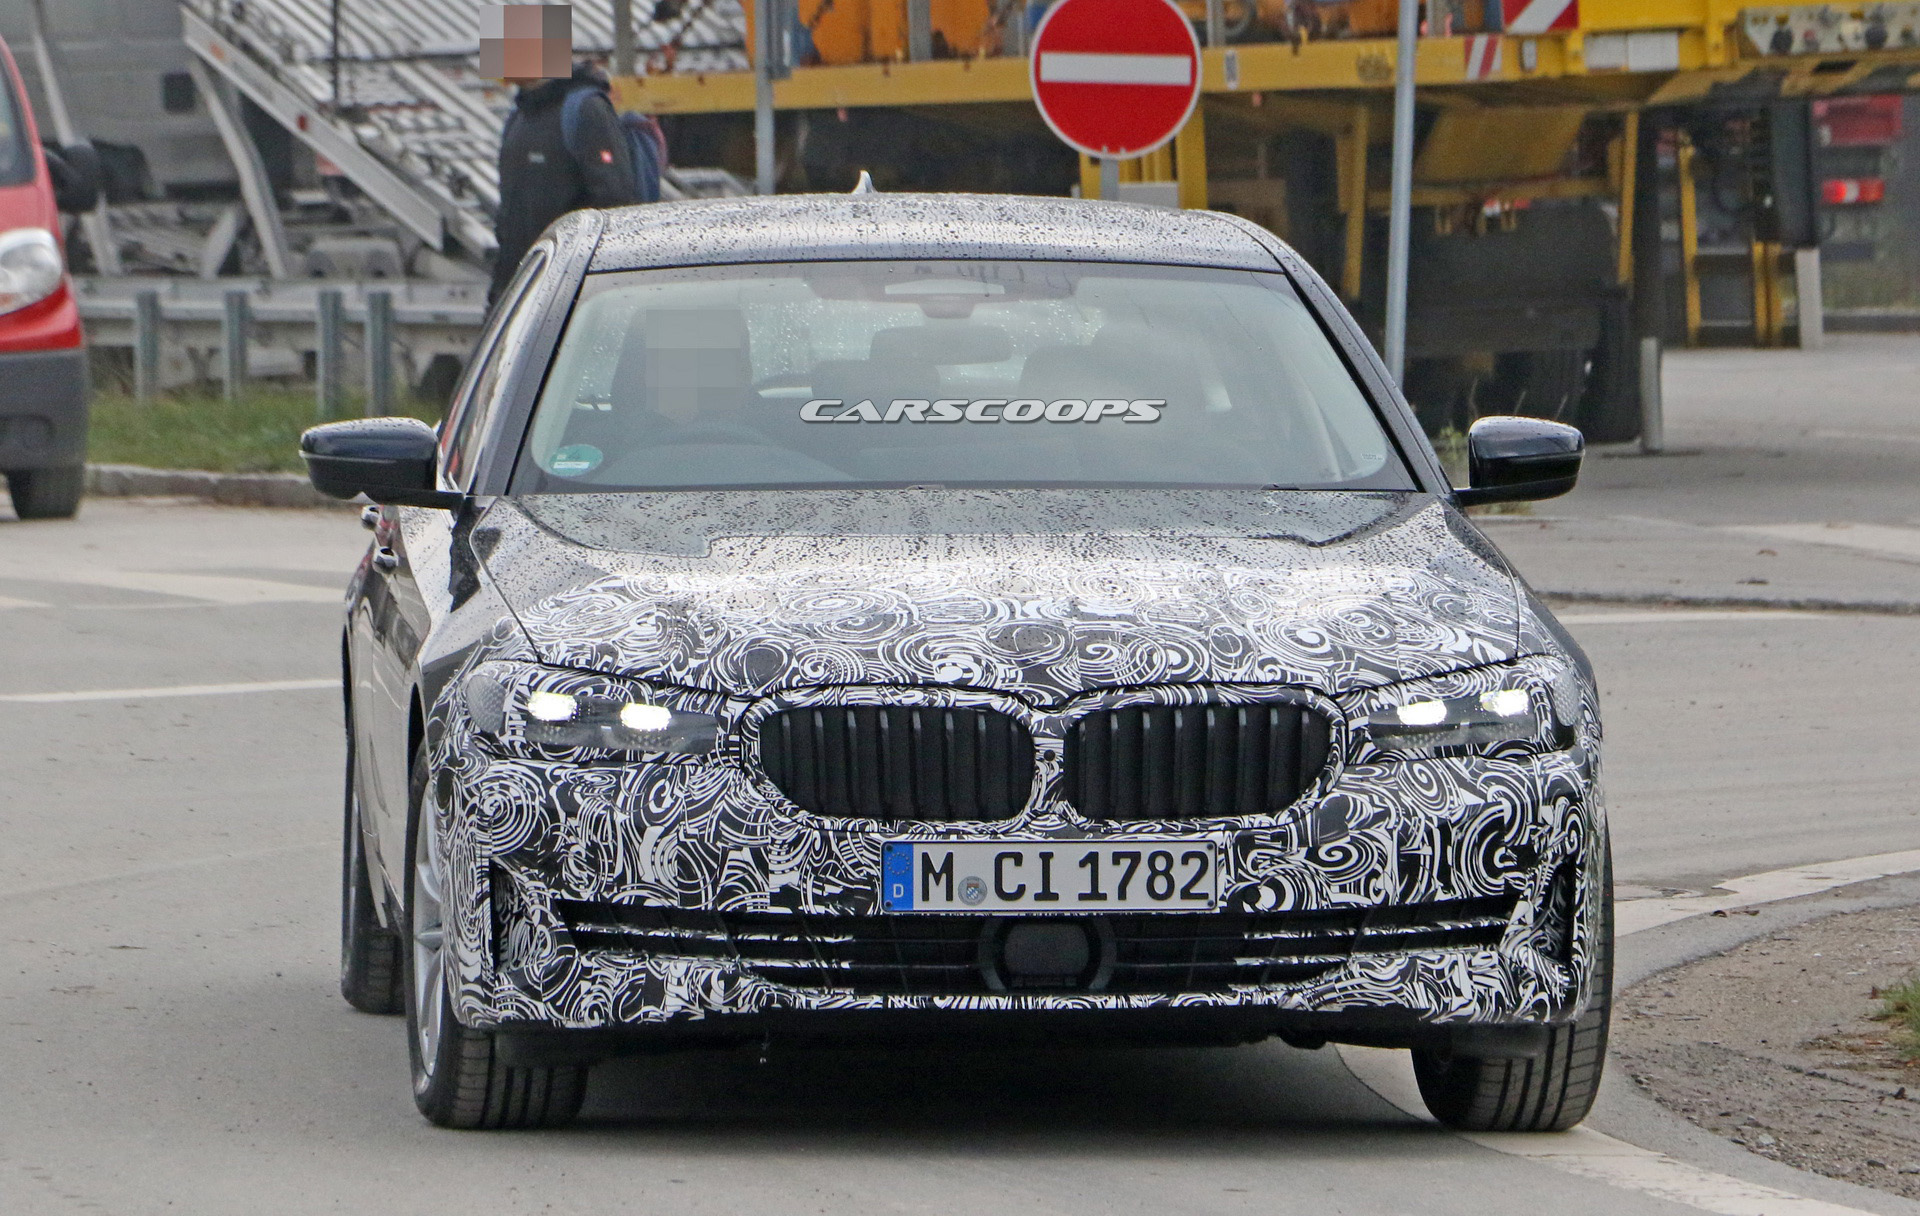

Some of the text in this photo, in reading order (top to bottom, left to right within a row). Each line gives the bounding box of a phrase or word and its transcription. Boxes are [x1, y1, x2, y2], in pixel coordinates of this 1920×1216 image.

[892, 884, 904, 899] D
[921, 850, 1210, 902] M CI 1782
